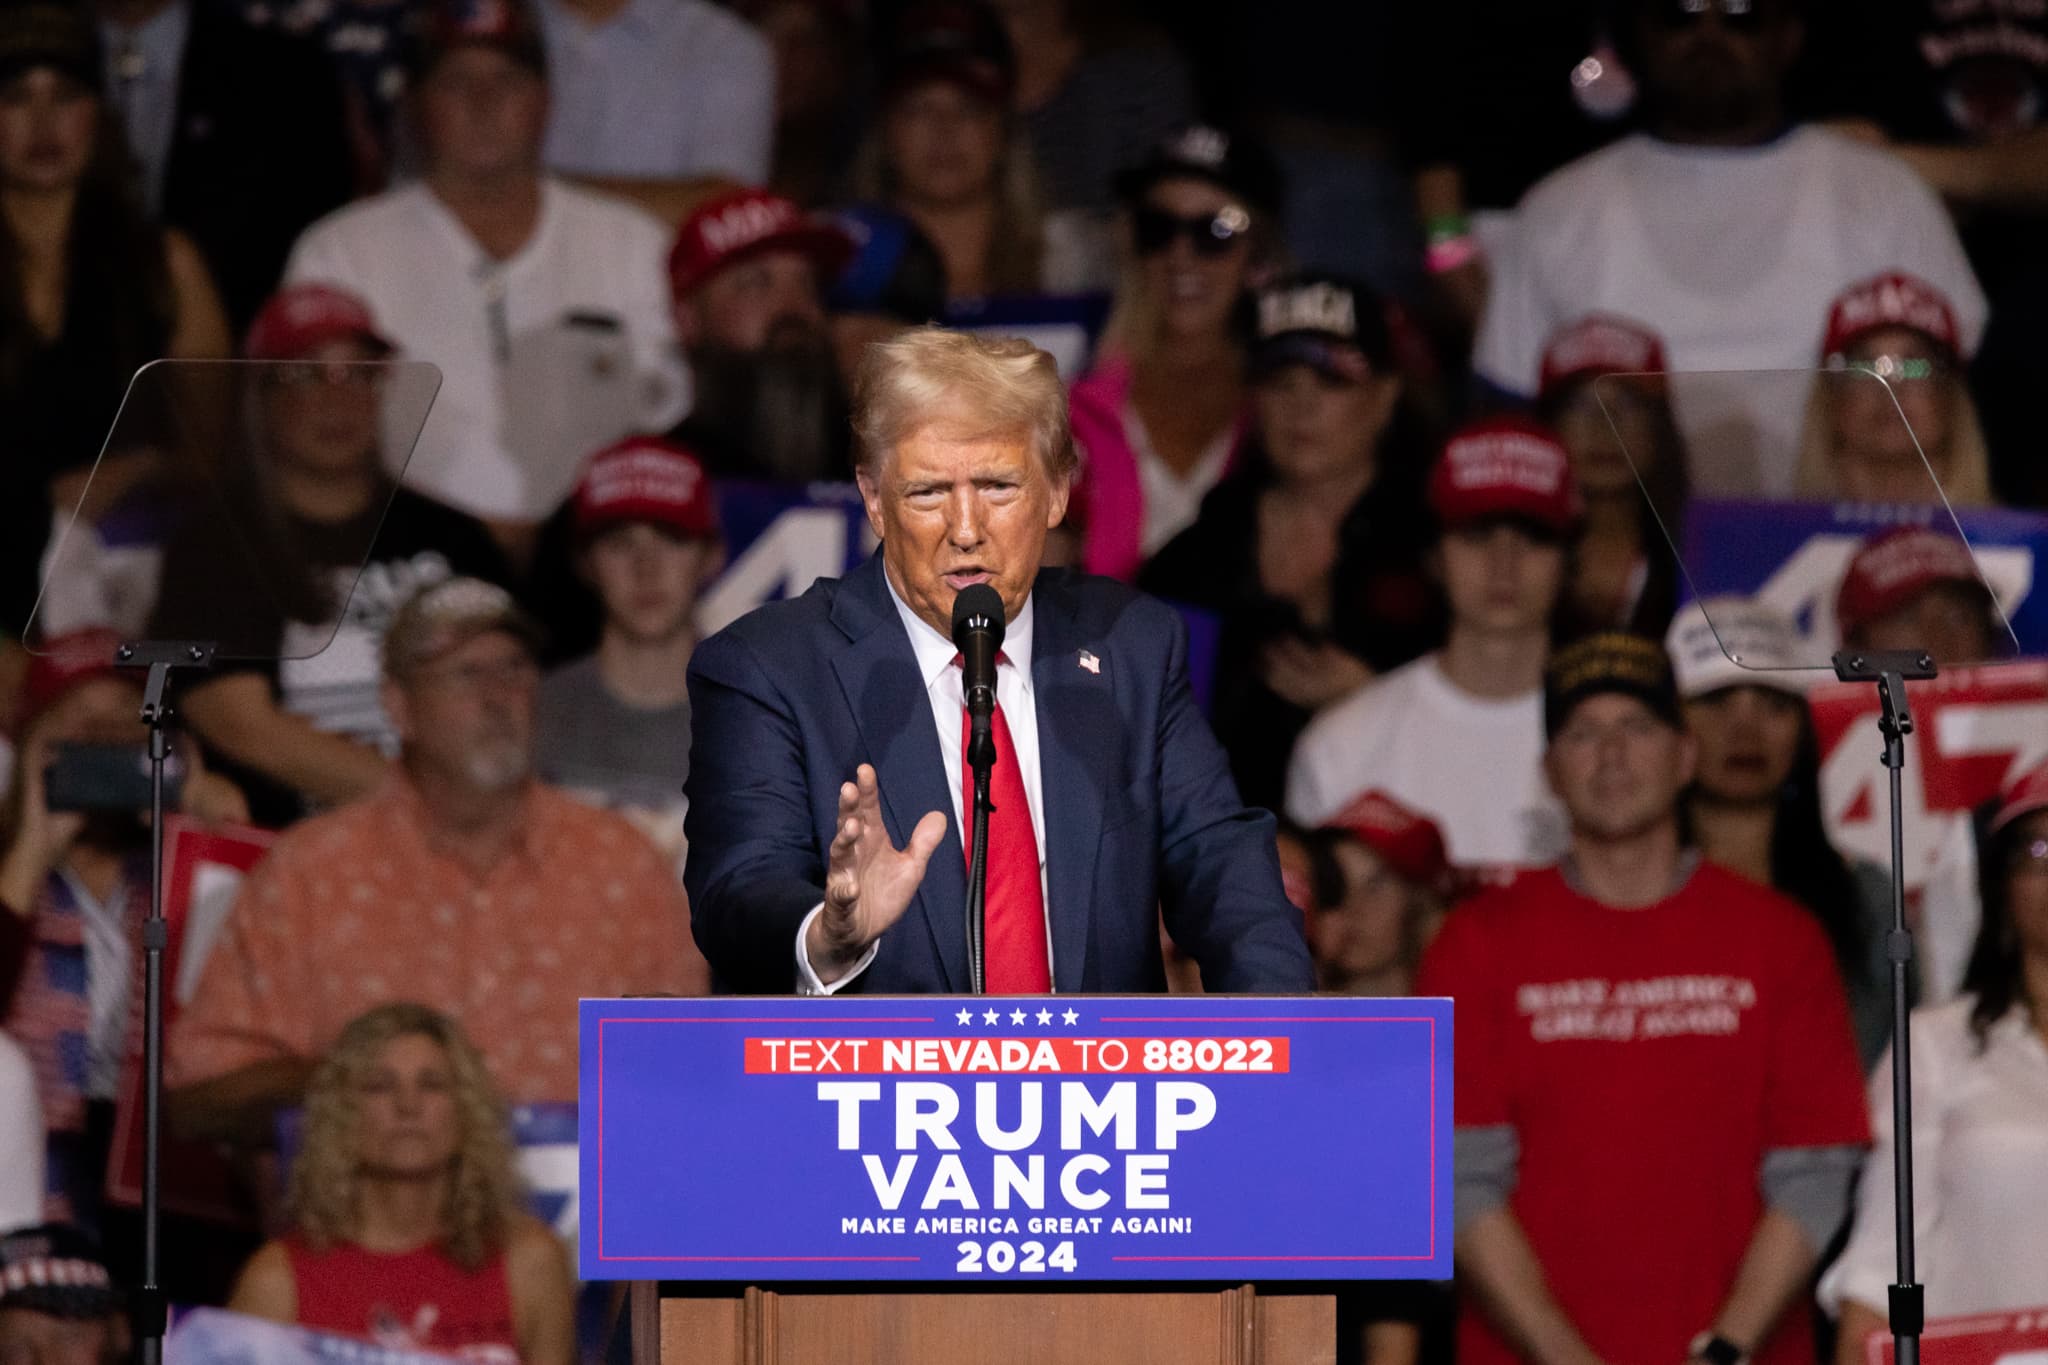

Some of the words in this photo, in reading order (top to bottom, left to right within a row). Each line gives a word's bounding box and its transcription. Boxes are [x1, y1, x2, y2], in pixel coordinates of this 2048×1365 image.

[1516, 977, 1608, 1015] MAKE
[1612, 974, 1757, 1010] AMERICA
[762, 1040, 868, 1071] TEXT
[883, 1040, 1060, 1071] NEVADA
[1074, 1040, 1128, 1071] TO
[1143, 1040, 1272, 1071] 88022
[818, 1082, 1216, 1151] TRUMP
[862, 1154, 1169, 1210] VANCE
[842, 1218, 905, 1233] MAKE
[915, 1218, 1019, 1233] AMERICA
[1028, 1218, 1102, 1233] GREAT
[1111, 1218, 1191, 1233] AGAIN!
[957, 1241, 1077, 1272] 2024
